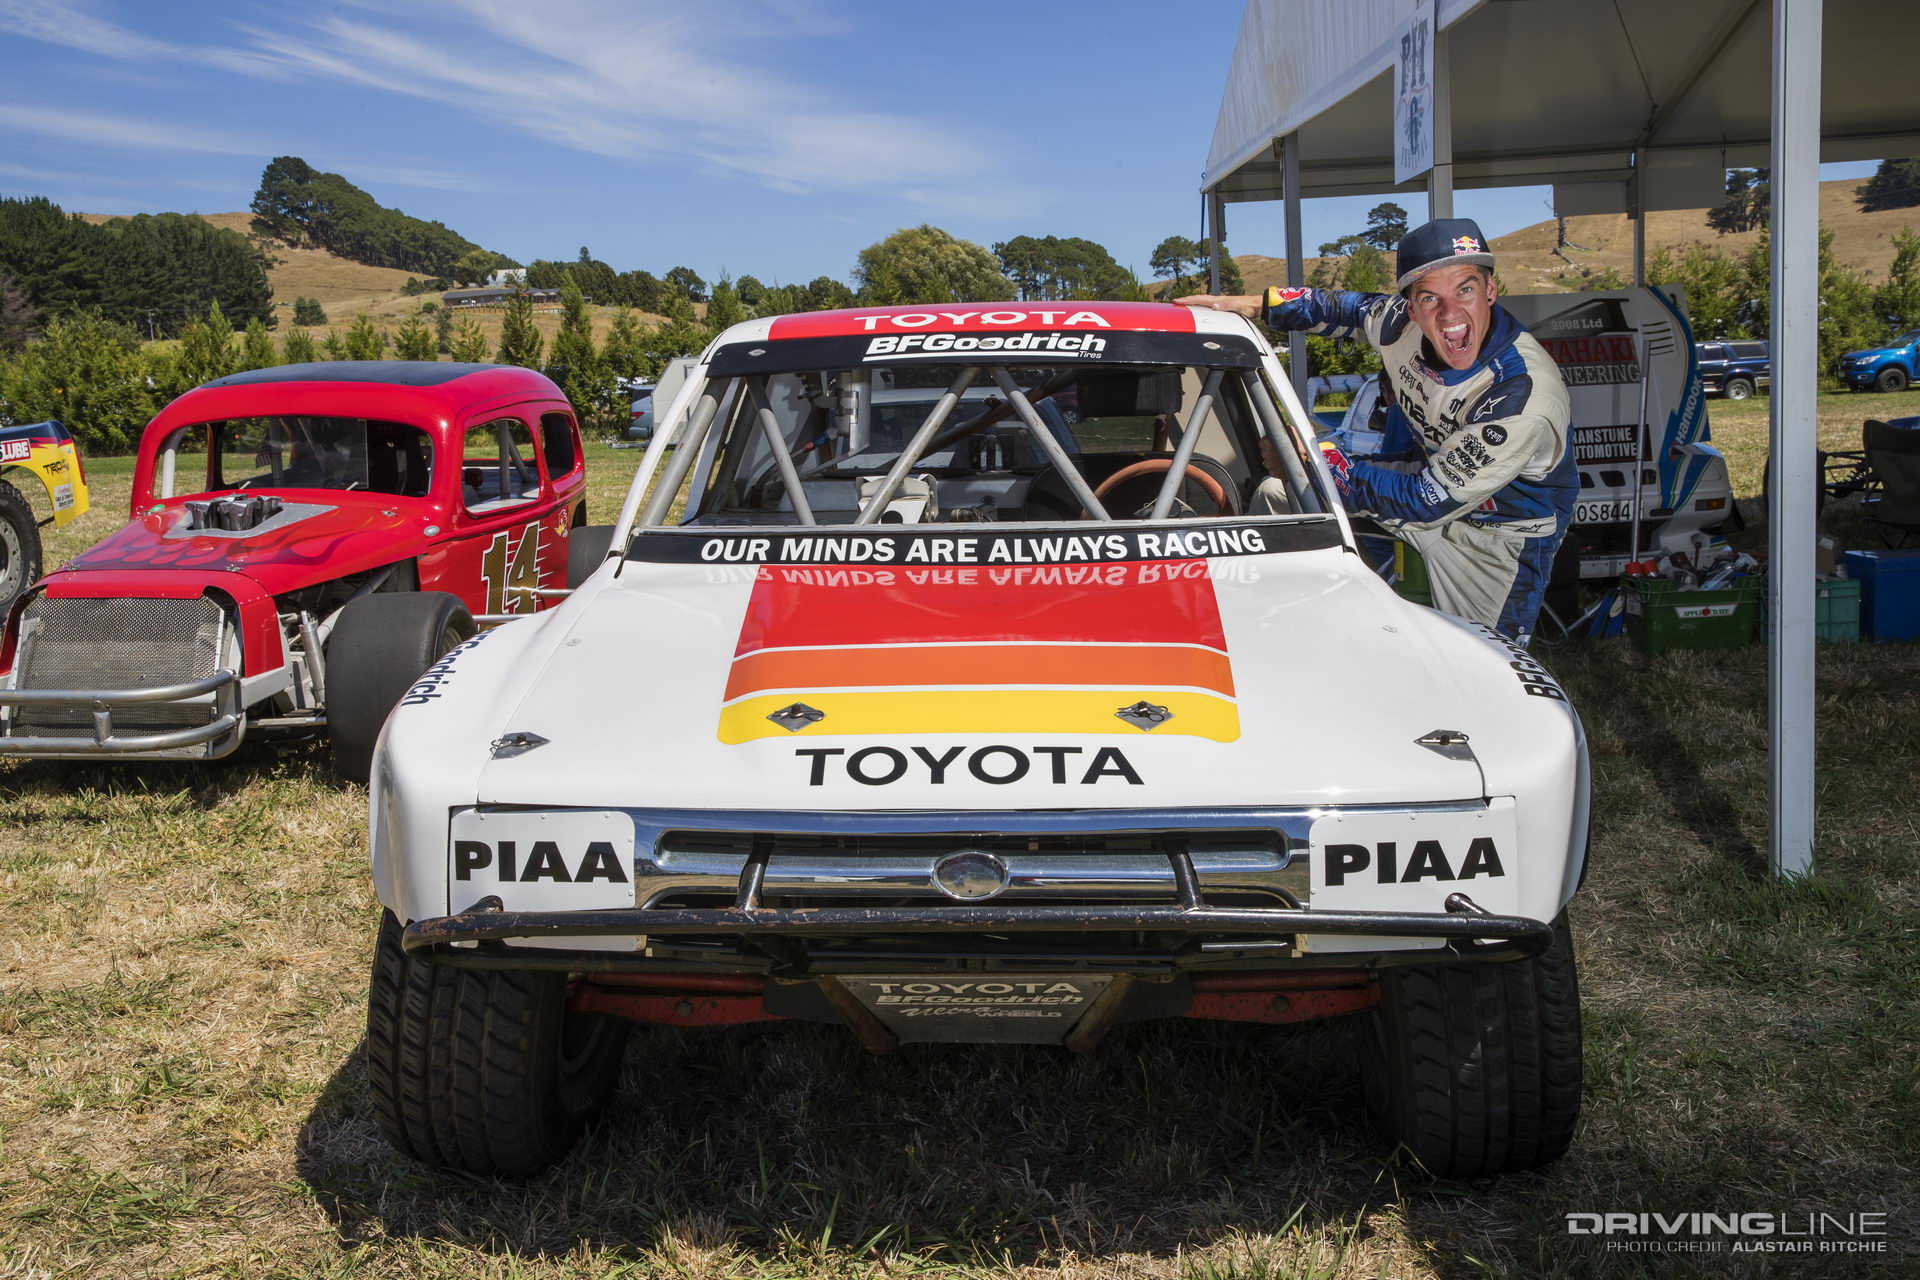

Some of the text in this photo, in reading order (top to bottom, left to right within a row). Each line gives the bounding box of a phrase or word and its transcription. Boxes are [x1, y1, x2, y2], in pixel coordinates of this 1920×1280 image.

[854, 311, 1111, 330] TOYOTA
[1552, 318, 1604, 330] 2008 Ltd
[865, 332, 1106, 354] BFGoodrich
[1079, 350, 1102, 359] Tires
[701, 529, 1267, 563] OUR MINDS ARE ALWAYS RACING
[481, 520, 541, 628] 14
[795, 744, 1145, 786] TOYOTA
[454, 840, 629, 884] PIAA
[1324, 837, 1506, 887] PIAA
[869, 982, 1081, 994] TOYOTA
[875, 995, 1084, 1004] BFGoodrich
